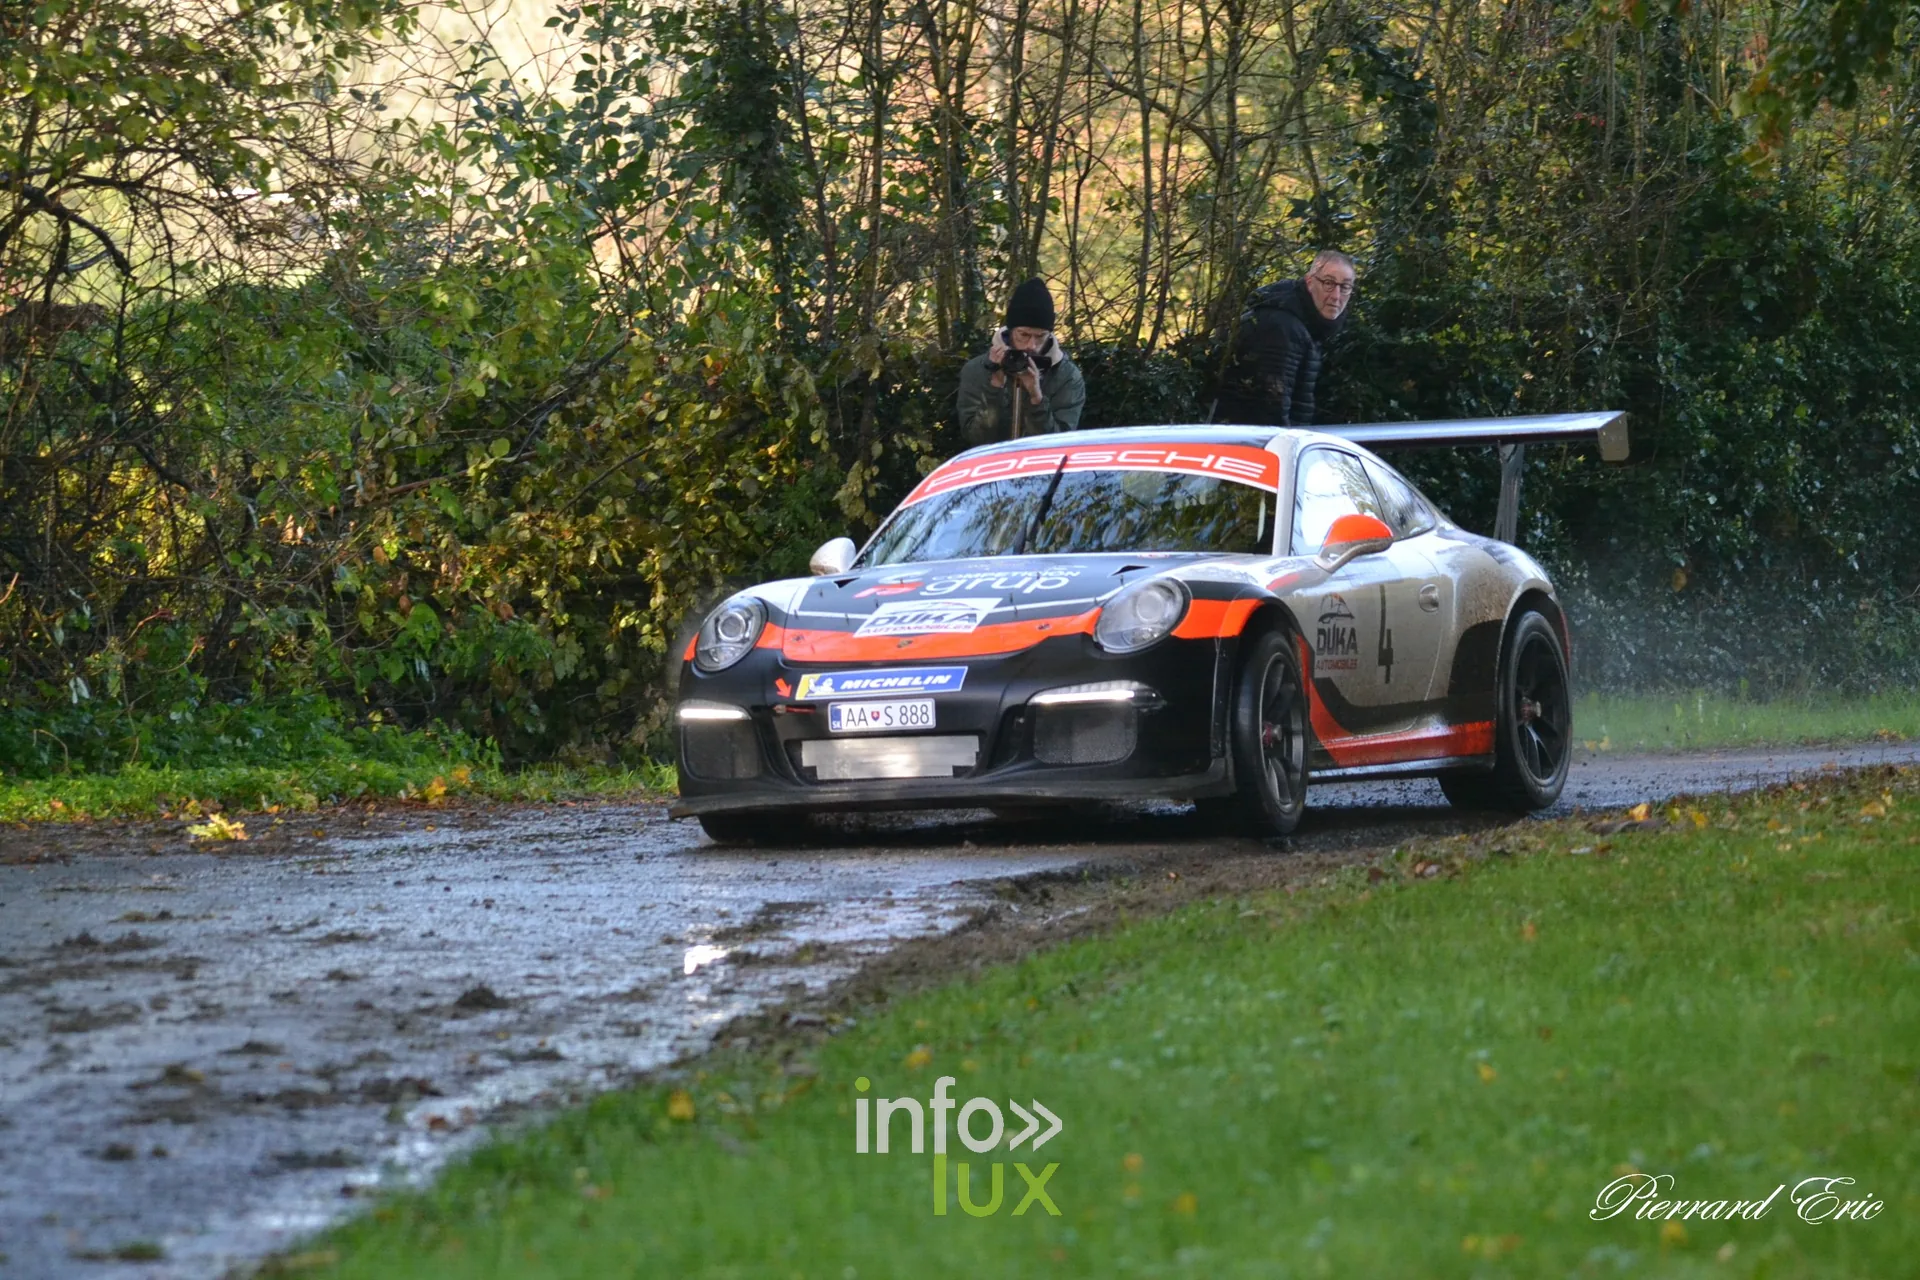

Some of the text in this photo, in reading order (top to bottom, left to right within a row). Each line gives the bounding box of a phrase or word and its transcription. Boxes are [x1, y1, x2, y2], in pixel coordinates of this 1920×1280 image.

[925, 450, 1267, 493] PORSCHE
[919, 575, 1070, 596] grup
[865, 612, 978, 628] DUKA
[1378, 584, 1394, 684] 4
[840, 675, 952, 690] MICHELIN
[846, 704, 930, 727] AA S 888
